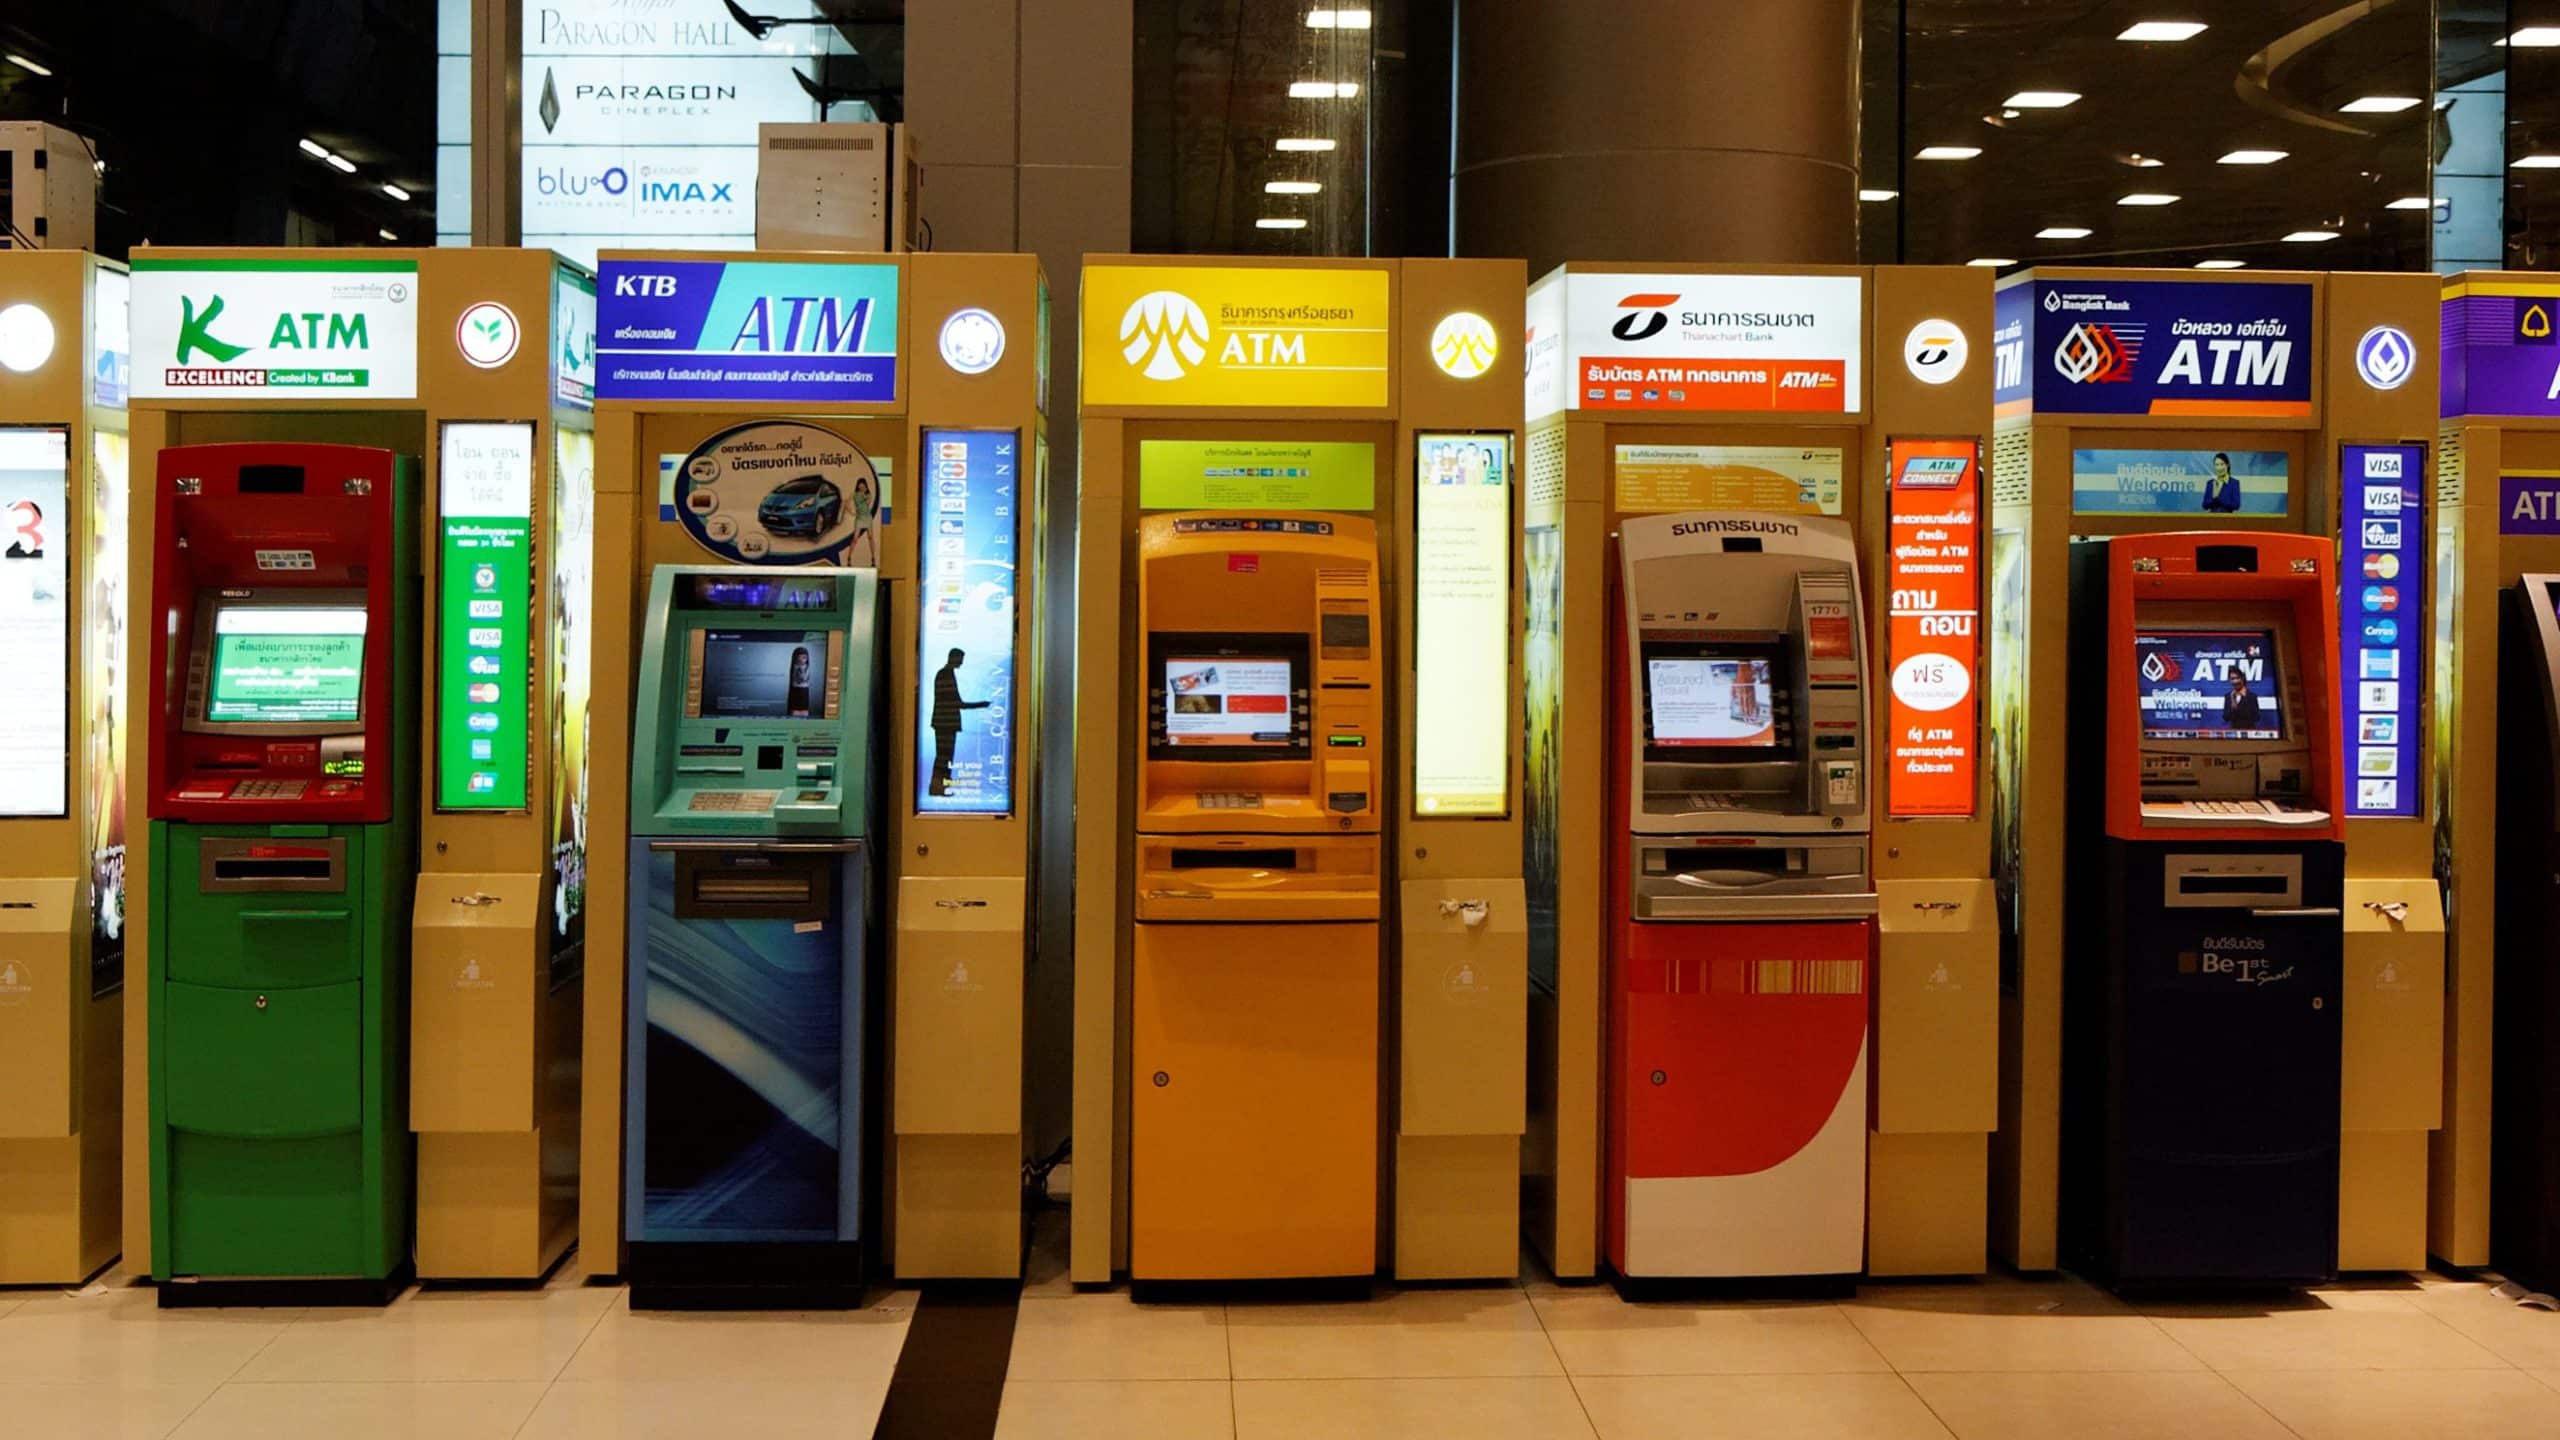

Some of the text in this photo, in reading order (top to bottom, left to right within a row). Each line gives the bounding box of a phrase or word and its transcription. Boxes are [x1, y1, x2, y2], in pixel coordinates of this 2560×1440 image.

[540, 9, 736, 46] PARAGON HALL
[576, 86, 735, 99] PARAGON
[601, 107, 711, 115] CINEPLEX
[641, 183, 733, 202] IMAX
[615, 275, 874, 353] KTB ATM
[2062, 301, 2130, 313] Bangkok Bank
[1682, 311, 1815, 327] ธนาคารธนชาต
[177, 294, 369, 366] K ATM
[2173, 318, 2287, 337] บัวหลวง เอทีเอ็ม
[1682, 330, 1774, 342] Thanachart Bank
[1220, 334, 1306, 363] ATM
[2157, 339, 2292, 385] ATM
[167, 371, 355, 385] EXCELLENCE Created by KBank
[1646, 369, 1682, 382] ATM
[1780, 371, 1818, 388] ATM
[732, 455, 816, 471] บัตรแบงก์ไหน
[1929, 461, 1956, 470] ATM
[2369, 460, 2399, 472] VISA
[995, 444, 1011, 517] BANK
[2118, 477, 2195, 492] Welcome
[2369, 493, 2399, 505] VISA
[2512, 491, 2560, 520] AT
[1672, 520, 1799, 537] ธนาคารธนชาต
[1941, 546, 1969, 557] ATM
[1892, 590, 1937, 609] ถาม
[475, 603, 500, 613] VISA
[1811, 606, 1840, 615] 1770
[1920, 616, 1970, 635] ถอน
[2192, 659, 2263, 681] ATM
[2155, 700, 2208, 710] Welcome
[1926, 729, 1953, 740] ATM
[2202, 953, 2234, 972] Be
